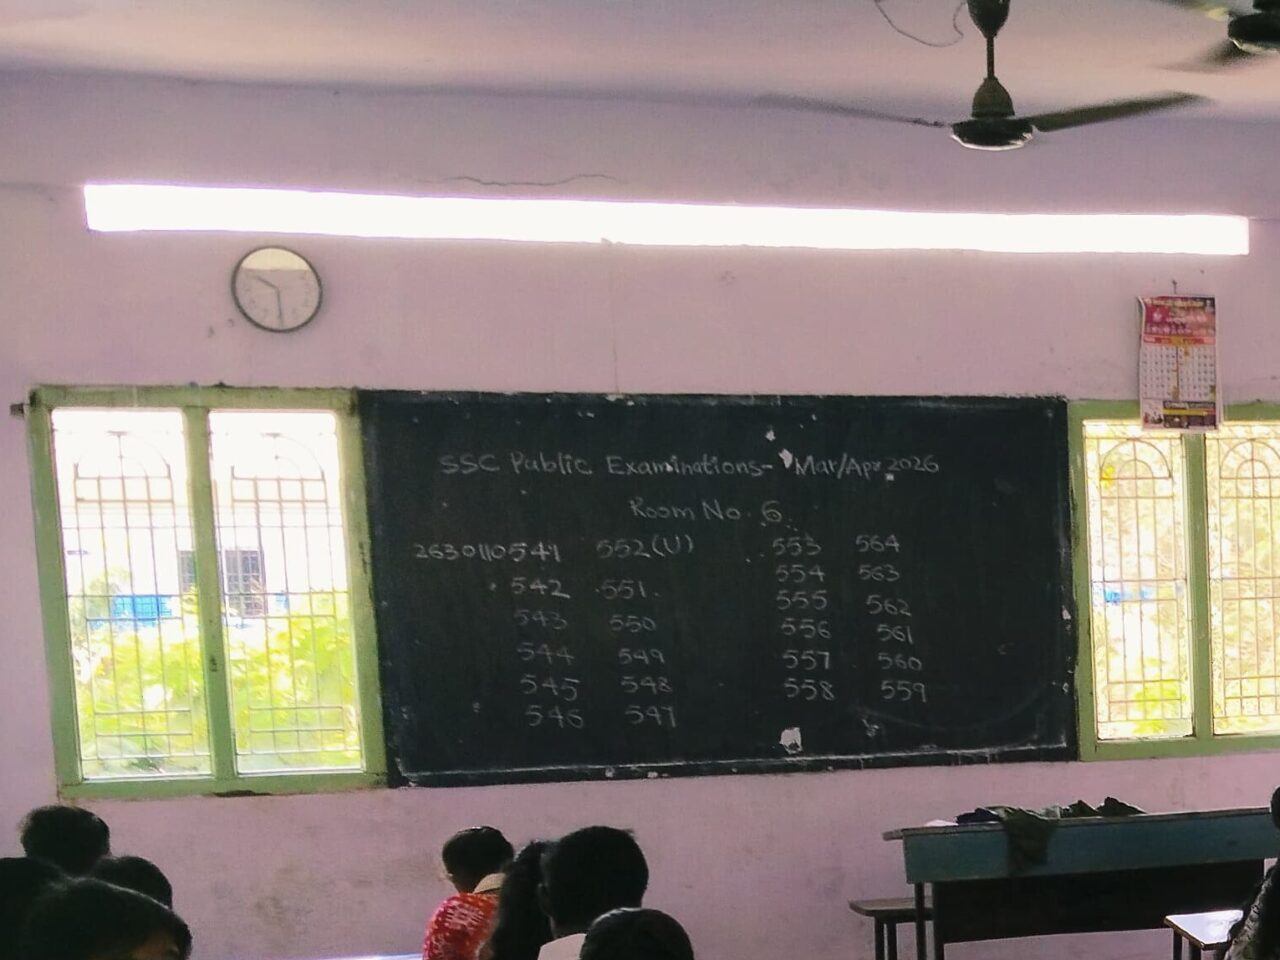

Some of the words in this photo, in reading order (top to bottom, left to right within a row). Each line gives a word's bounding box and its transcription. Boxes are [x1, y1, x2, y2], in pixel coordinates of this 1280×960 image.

[439, 453, 501, 475] SSC
[509, 451, 594, 476] Public
[794, 452, 882, 480] Mar/Apr
[885, 454, 940, 477] 2026
[628, 496, 696, 521] Room
[760, 499, 783, 523] 6
[413, 540, 561, 563] 2630110541
[596, 533, 694, 559] 552(U)
[771, 533, 822, 557] 553
[855, 533, 901, 553] 564
[775, 563, 826, 583] 554
[858, 563, 901, 582] 563
[510, 576, 572, 600] 542
[600, 579, 646, 600] 551
[775, 589, 828, 611] 555
[865, 594, 913, 617] 562
[513, 609, 569, 630] 543
[609, 613, 657, 633] 550
[780, 617, 831, 639] 556
[876, 623, 914, 645] 561
[516, 641, 575, 666] 544
[617, 647, 666, 665] 549
[781, 649, 831, 671] 557
[877, 652, 923, 671] 560
[519, 673, 581, 702] 545
[620, 675, 673, 695] 548
[783, 677, 835, 701] 558
[880, 679, 927, 703] 559
[525, 704, 584, 729] 546
[624, 704, 677, 729] 547
